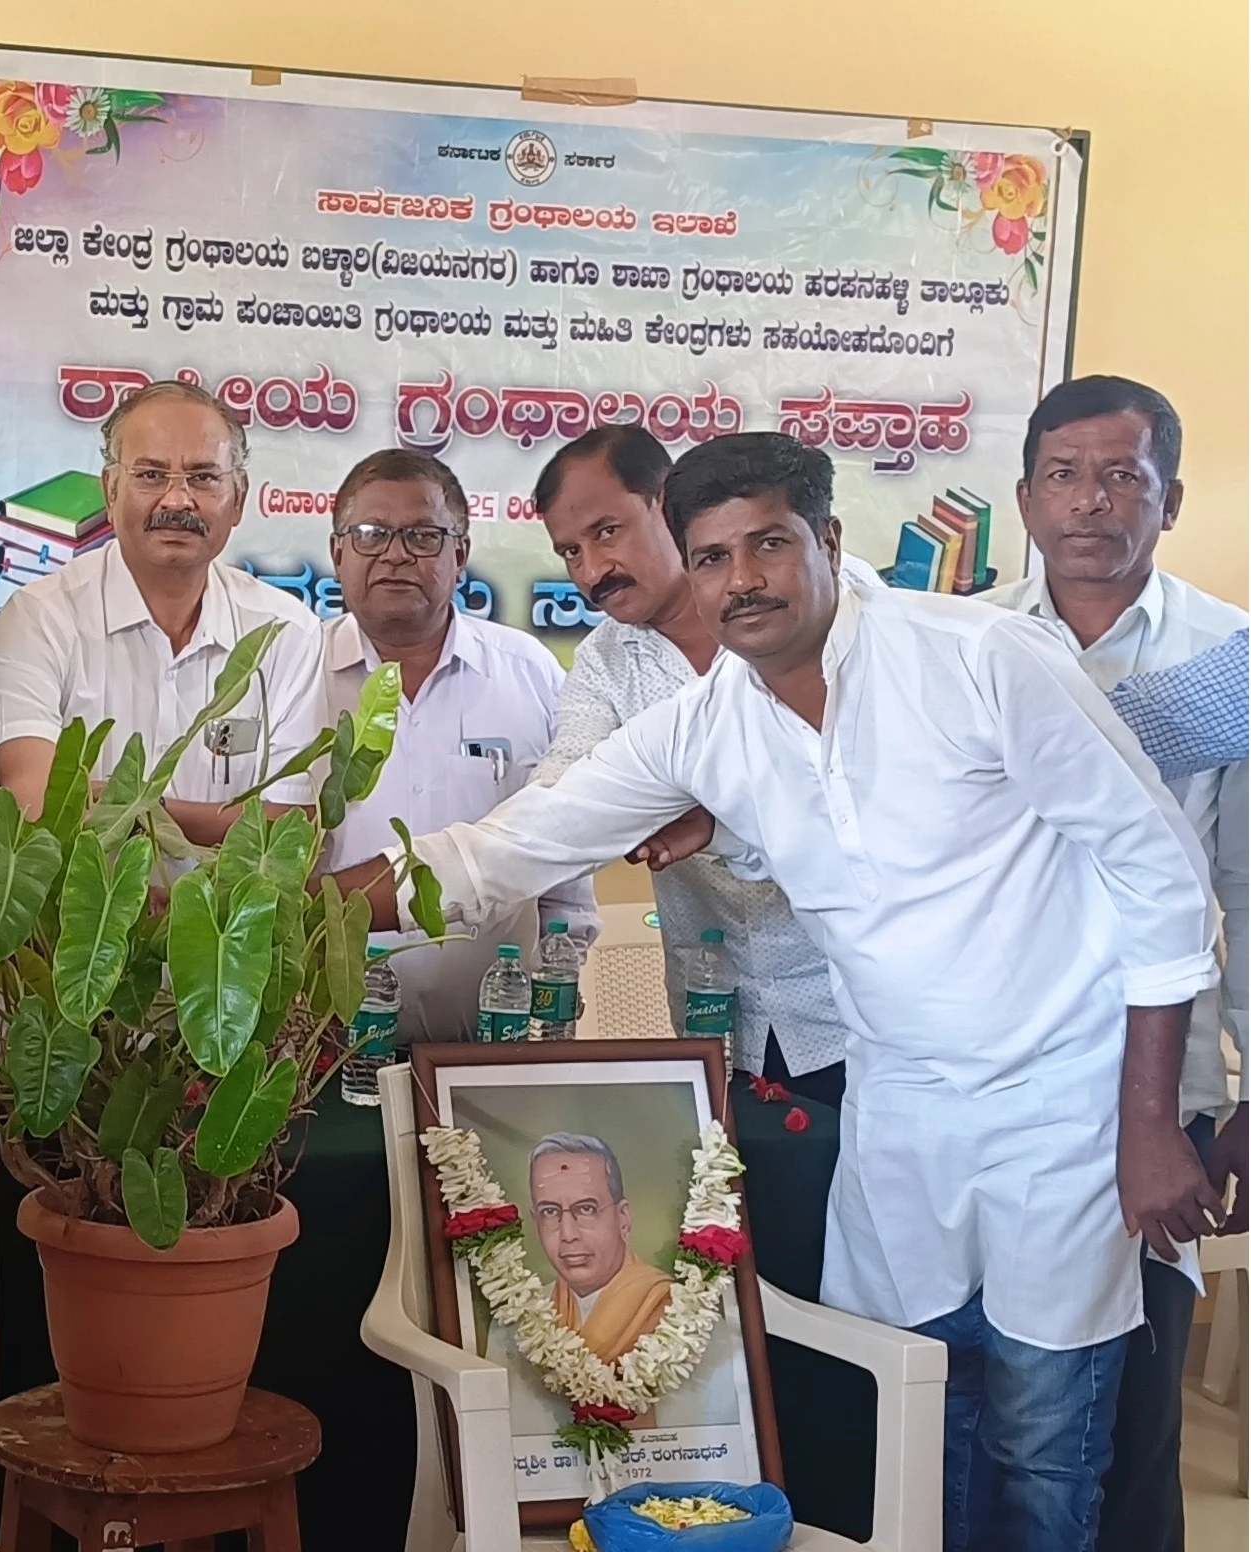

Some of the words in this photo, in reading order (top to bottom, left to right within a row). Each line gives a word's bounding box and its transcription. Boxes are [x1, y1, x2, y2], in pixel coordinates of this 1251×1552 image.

[438, 144, 501, 161] ಕರ್ನಾಟಕ
[564, 152, 616, 168] ಸರ್ಕಾರ
[317, 190, 472, 219] ಸಾರ್ವಜನಿಕ
[489, 198, 636, 231] ಗ್ರಂಥಾಲಯ
[652, 210, 737, 236] ಇಲಾಖೆ
[15, 226, 69, 265] ಜಿಲ್ಲಾ
[82, 224, 152, 270] ಕೇಂದ್ರ
[166, 230, 289, 272] ಗ್ರಂಥಾಲಯ
[530, 255, 600, 285] ಹಾಗೂ
[612, 262, 670, 289] ಶಾಖಾ
[682, 261, 793, 300] ಗ್ರಂಥಾಲಯ
[805, 267, 910, 315] ಹರಪನಹಳ್ಳಿ
[920, 276, 1010, 314] ತಾಲ್ಲೂಕು
[90, 284, 149, 329] ಮತ್ತು
[163, 290, 224, 331] ಗ್ರಾಮ
[237, 292, 362, 329] ಪಂಚಾಯಿತಿ
[374, 301, 492, 341] ಗ್ರಂಥಾಲಯ
[504, 307, 557, 350] ಮತ್ತು
[645, 314, 751, 355] ಕೇಂದ್ರಗಳು
[396, 367, 743, 457] ಗ್ರಂಥಾಲಯ
[779, 384, 973, 474] ಸಪ್ತಾಹ
[625, 1467, 652, 1479] 1972
